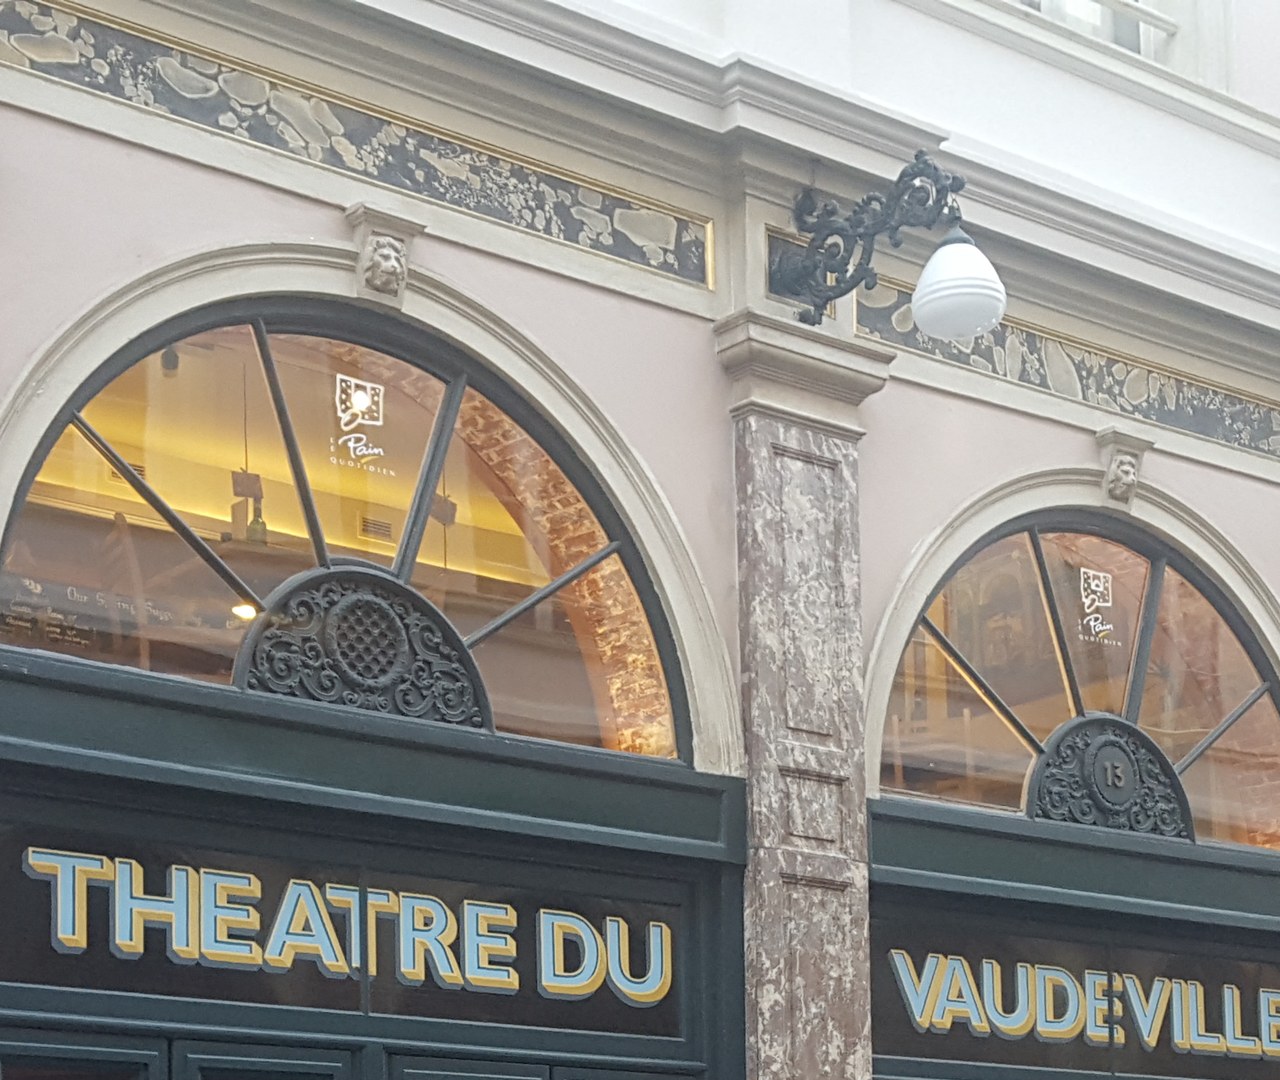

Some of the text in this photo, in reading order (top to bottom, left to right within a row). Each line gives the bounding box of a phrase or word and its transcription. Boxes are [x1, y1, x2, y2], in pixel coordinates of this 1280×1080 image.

[338, 433, 384, 459] Pain
[329, 455, 397, 477] QUOTIDIEN
[1083, 613, 1114, 635] Pain
[1103, 760, 1125, 788] 13
[22, 846, 673, 1008] THEATRE DU
